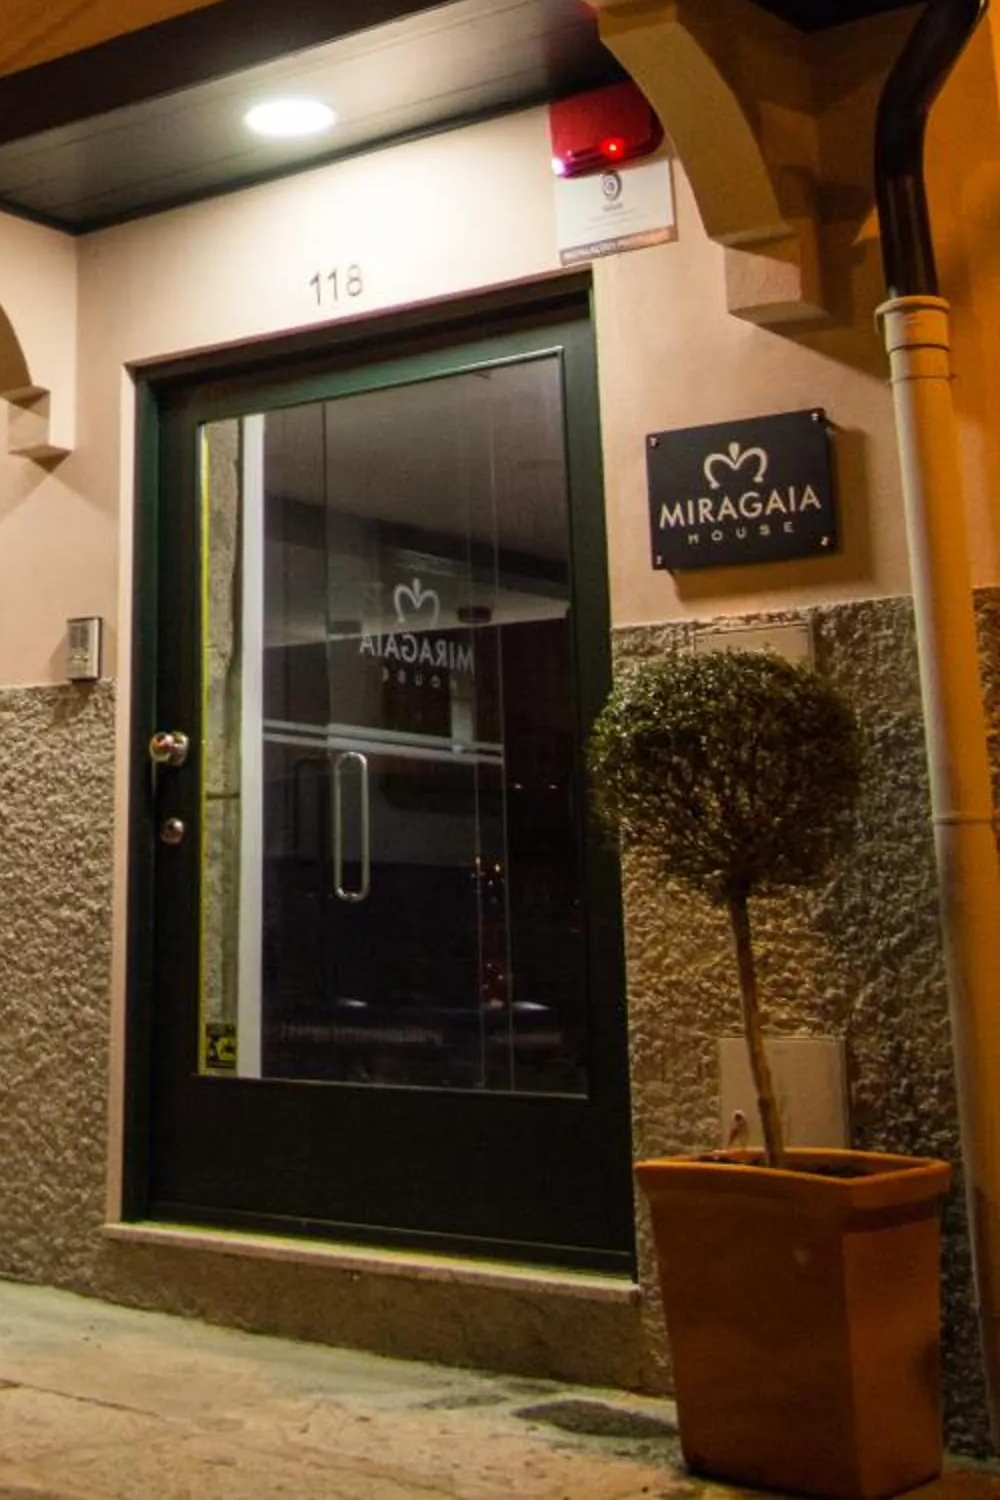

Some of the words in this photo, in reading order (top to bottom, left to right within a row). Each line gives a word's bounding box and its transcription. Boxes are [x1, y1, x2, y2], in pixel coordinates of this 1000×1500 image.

[308, 263, 363, 306] 118
[659, 484, 821, 530] MIRAGAIA
[687, 520, 795, 545] HOUSE
